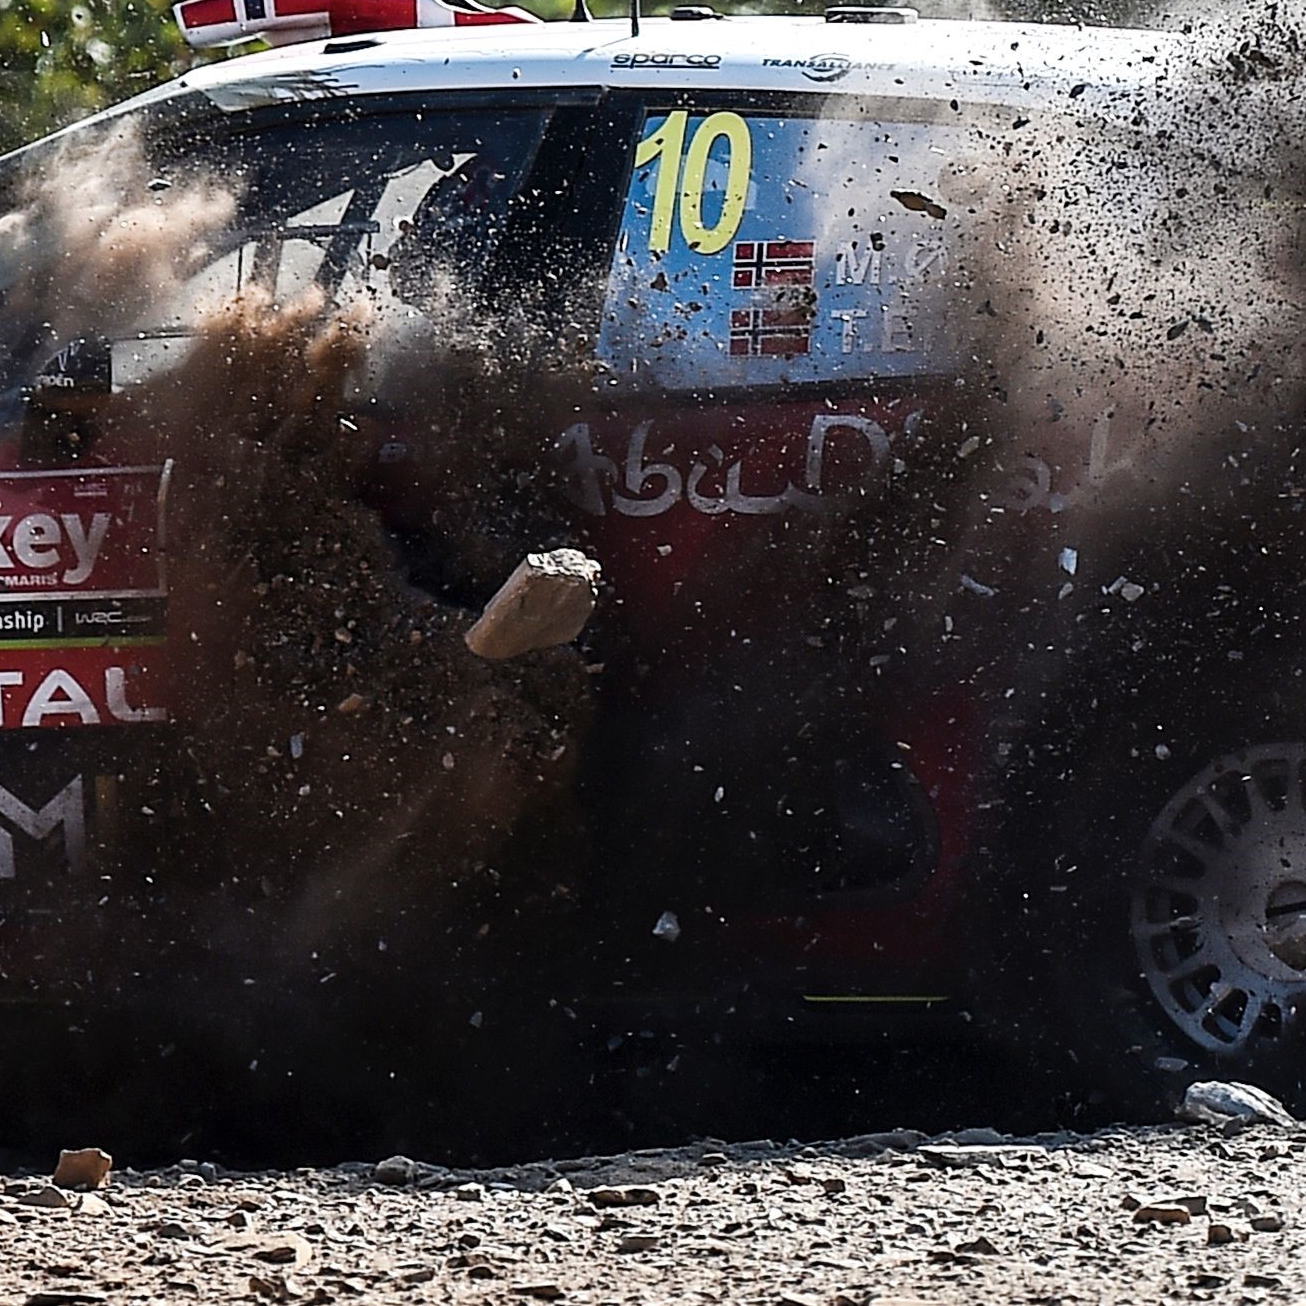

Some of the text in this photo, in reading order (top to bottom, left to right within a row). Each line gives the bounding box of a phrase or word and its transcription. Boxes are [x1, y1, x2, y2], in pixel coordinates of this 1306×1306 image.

[611, 52, 722, 70] sparco
[761, 57, 896, 72] TRANSALLIANCE
[634, 110, 752, 254] 10
